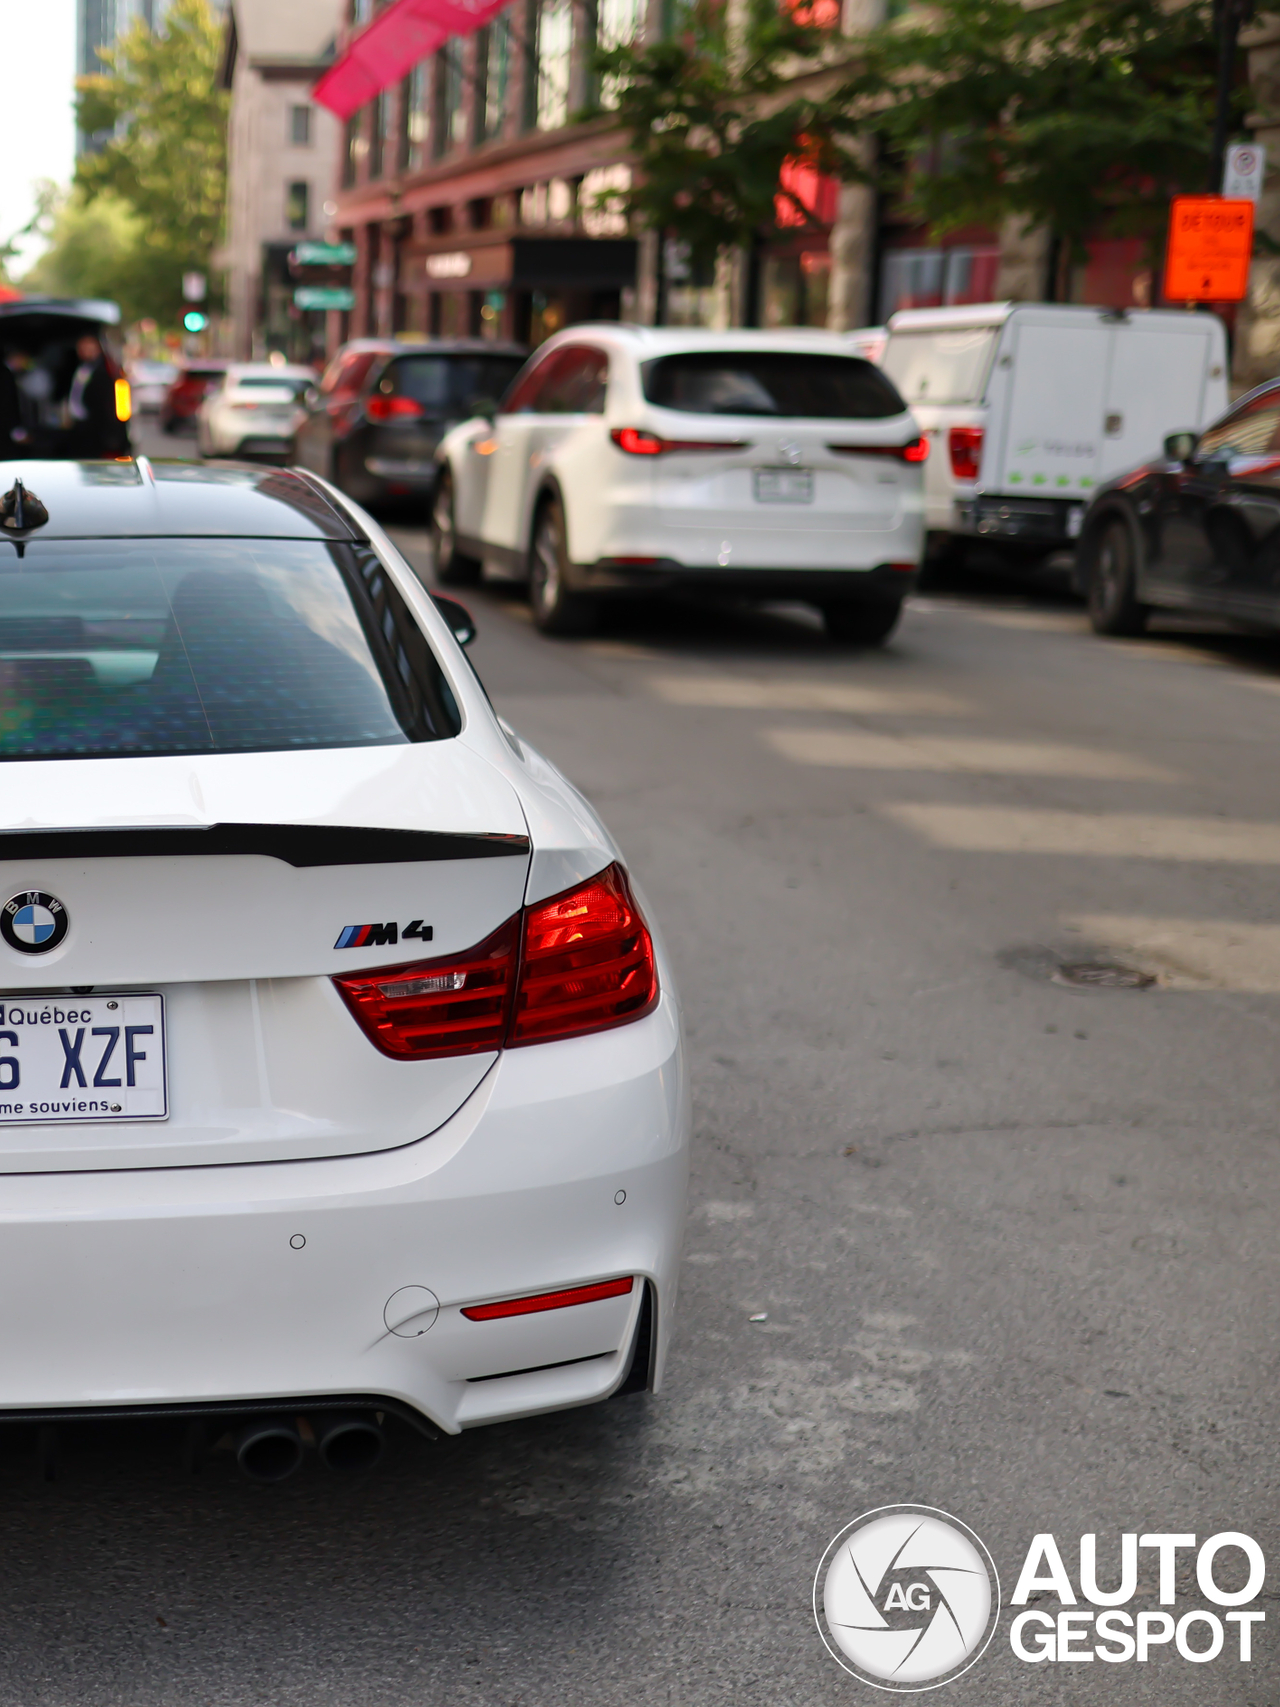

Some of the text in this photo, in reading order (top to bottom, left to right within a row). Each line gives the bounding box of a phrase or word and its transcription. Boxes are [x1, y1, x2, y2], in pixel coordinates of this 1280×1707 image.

[5, 892, 62, 915] BMW
[8, 1006, 92, 1025] Québec
[58, 1025, 154, 1088] XZF
[29, 1097, 109, 1113] souviens
